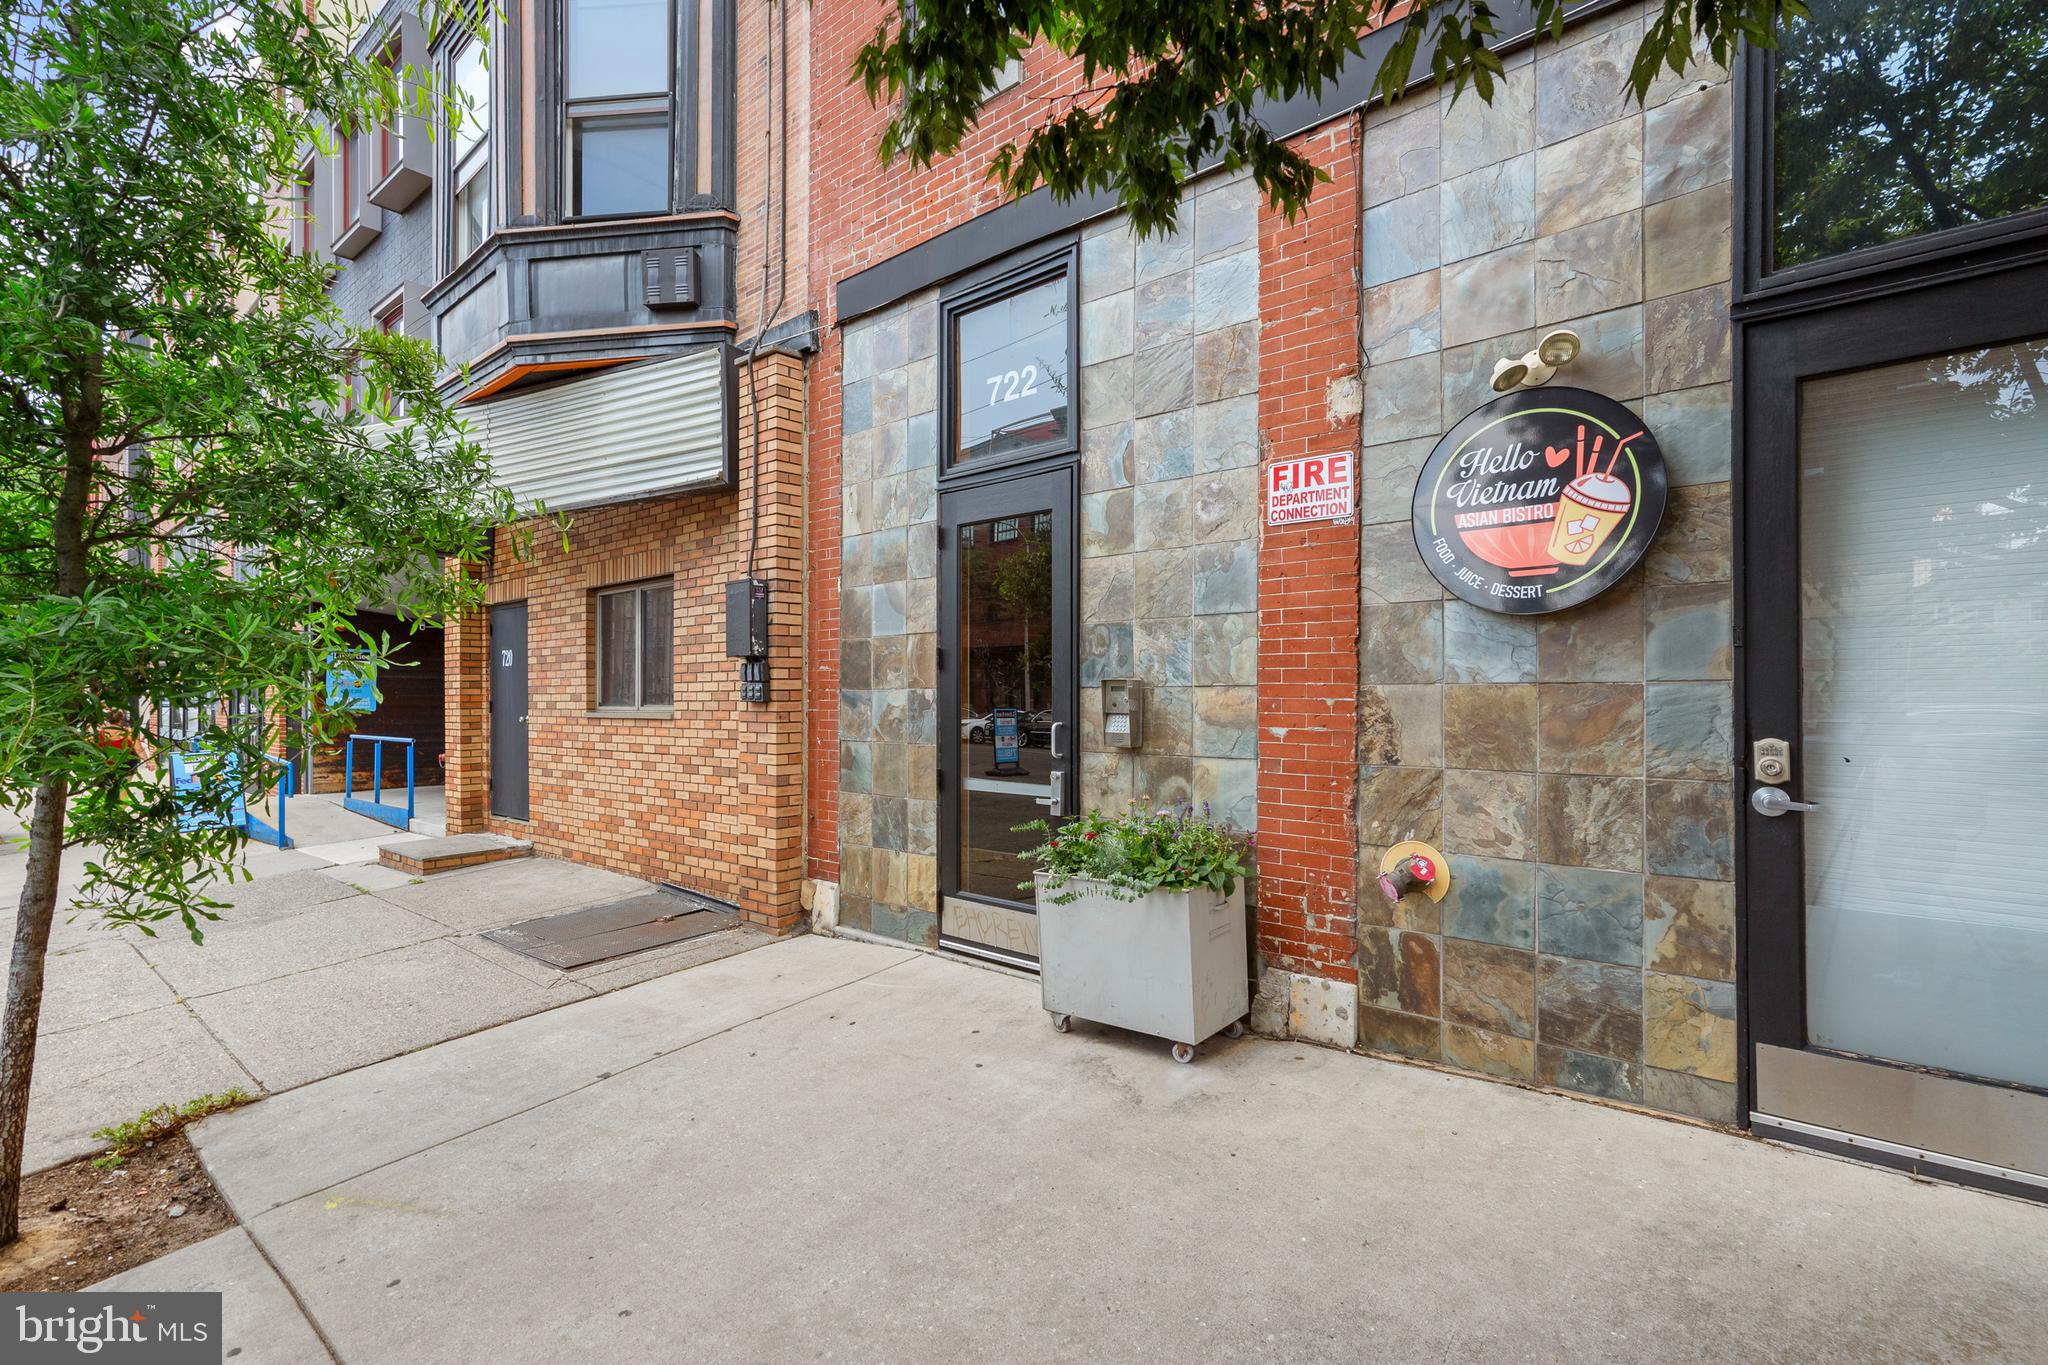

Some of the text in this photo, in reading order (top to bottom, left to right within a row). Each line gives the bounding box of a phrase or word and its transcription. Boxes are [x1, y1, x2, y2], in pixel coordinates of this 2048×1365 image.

[987, 365, 1038, 406] 722
[1273, 456, 1347, 492] FIRE
[1460, 443, 1540, 478] Hello
[1271, 486, 1349, 507] DEPARTMENT
[1446, 477, 1560, 508] Vietnam
[1270, 502, 1347, 522] CONNECTION
[1458, 503, 1555, 529] ASIAN BISTRO
[1433, 537, 1543, 599] FOOD JUICE DESSERT
[502, 649, 513, 667] 720
